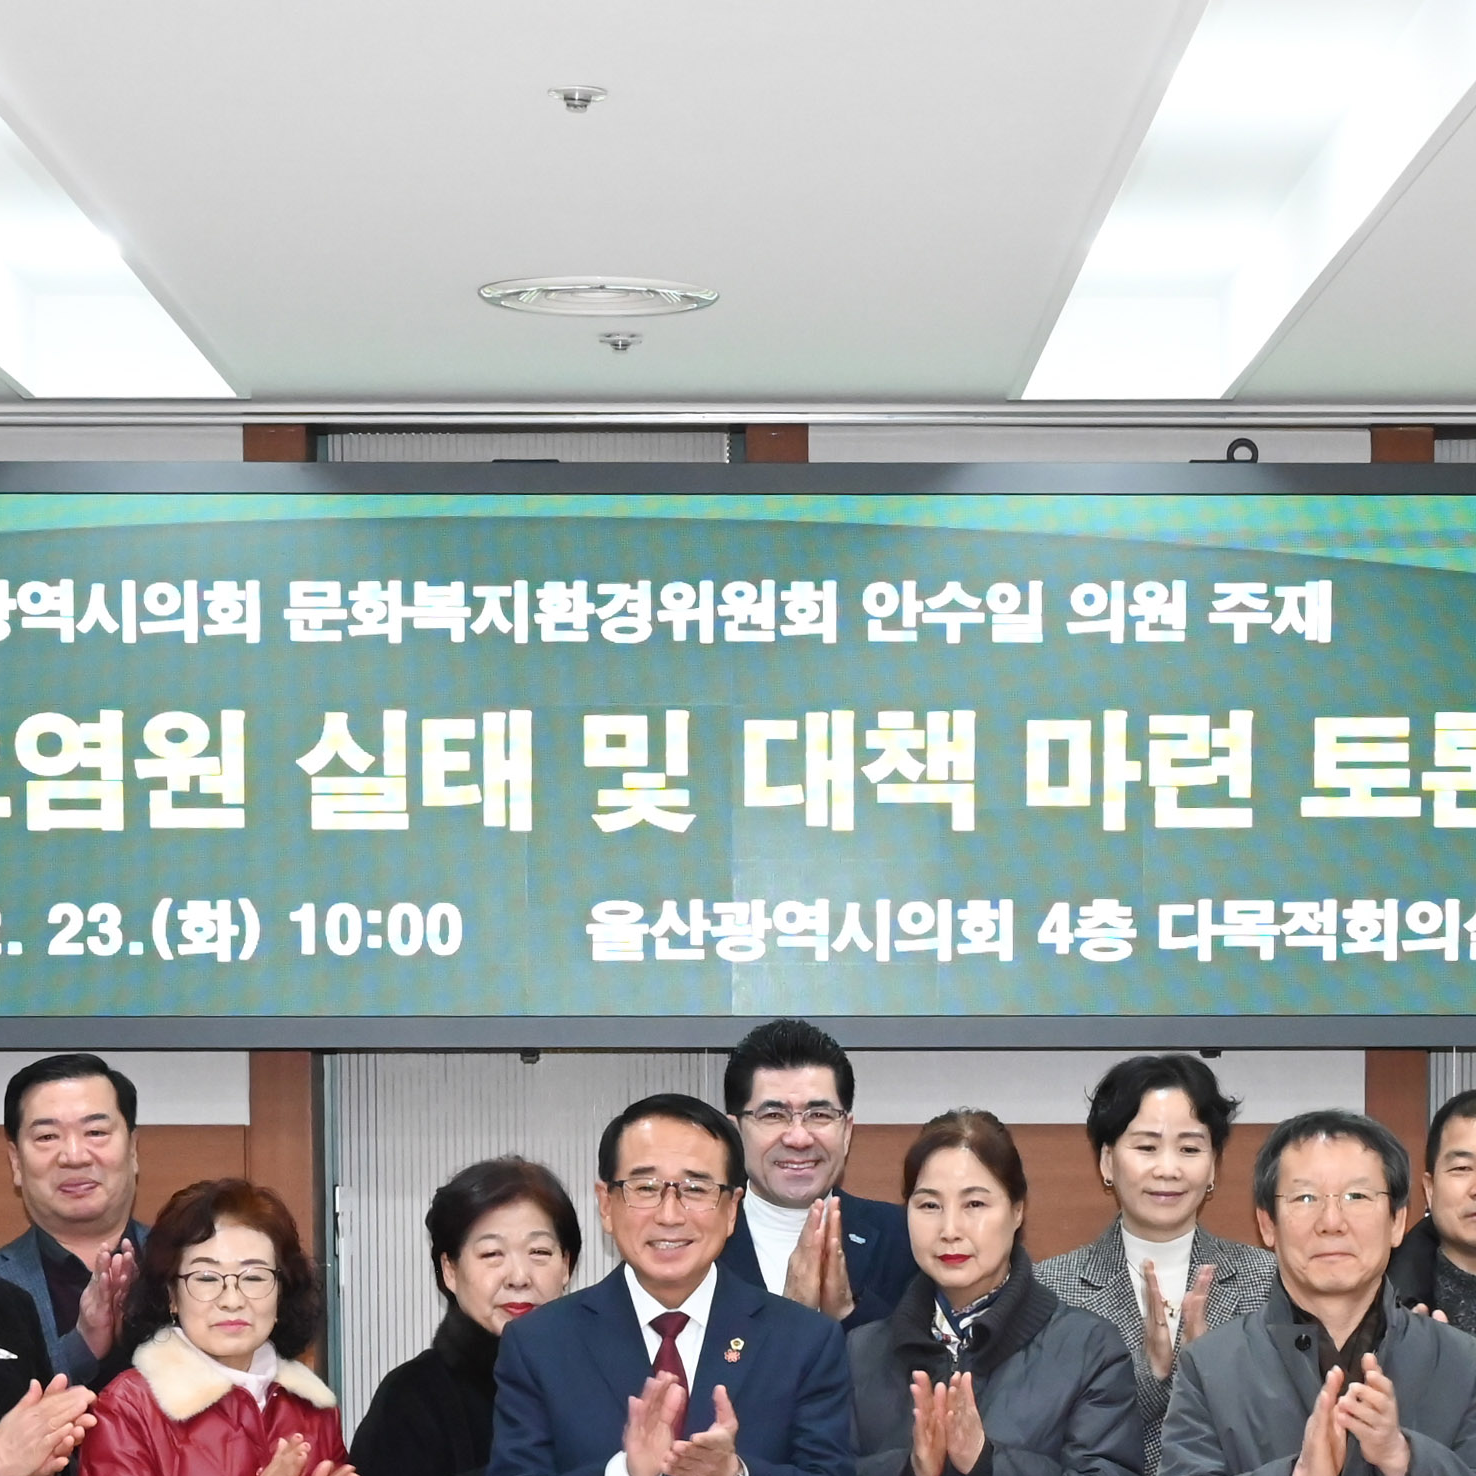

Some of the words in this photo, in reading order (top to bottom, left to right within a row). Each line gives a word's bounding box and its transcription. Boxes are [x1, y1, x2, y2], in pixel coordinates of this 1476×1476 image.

[283, 579, 837, 644] 문화복지환경위원회
[862, 580, 1043, 644] 안수일
[1066, 580, 1187, 644] 의원
[1208, 580, 1332, 644] 주재
[295, 709, 533, 832] 실태
[583, 709, 696, 833] 및
[744, 710, 976, 832] 대책
[1026, 710, 1254, 831] 마련
[289, 902, 463, 956] 10:00
[585, 898, 1014, 963] 울산광역시의회
[1037, 898, 1137, 962] 4층
